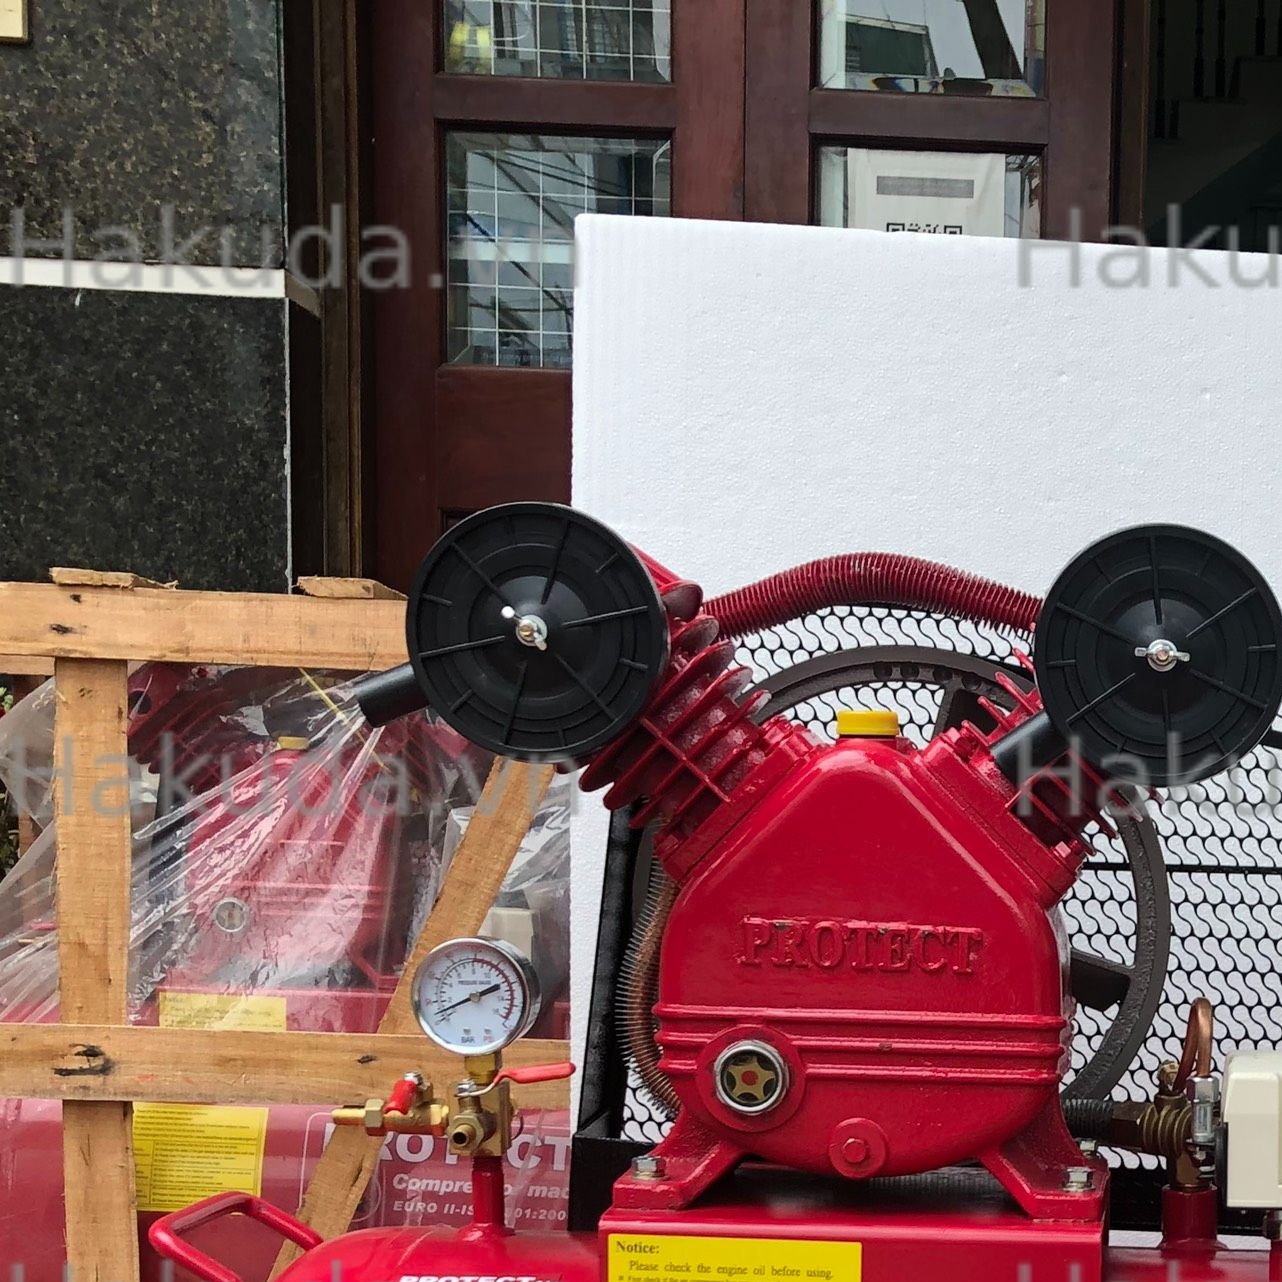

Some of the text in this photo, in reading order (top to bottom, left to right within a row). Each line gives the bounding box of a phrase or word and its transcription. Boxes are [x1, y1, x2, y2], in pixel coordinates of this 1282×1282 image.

[738, 917, 984, 975] PROTECT
[393, 1201, 436, 1213] EURO
[616, 1240, 660, 1254] Notice:
[629, 1260, 659, 1271] Please
[664, 1262, 692, 1273] check
[697, 1262, 712, 1273] the
[717, 1265, 748, 1277] engine
[753, 1265, 766, 1275] oil
[771, 1265, 801, 1277] before
